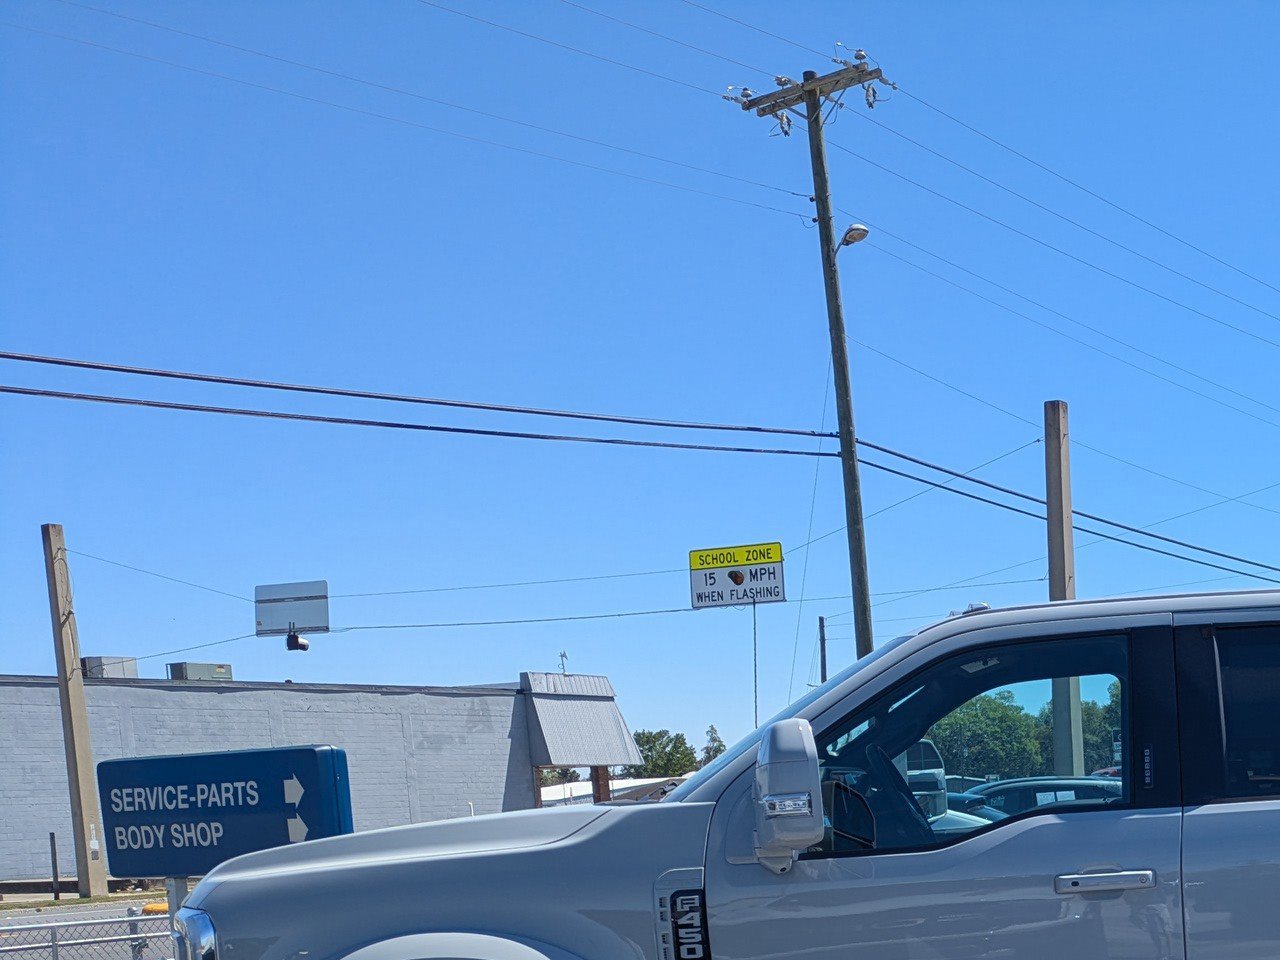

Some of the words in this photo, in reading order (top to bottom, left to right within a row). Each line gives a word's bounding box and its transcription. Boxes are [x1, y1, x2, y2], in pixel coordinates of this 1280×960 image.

[699, 552, 738, 565] SCHOOL
[745, 548, 772, 561] ZONE
[704, 572, 716, 586] 15
[749, 567, 776, 582] MPH
[696, 590, 724, 603] WHEN
[729, 585, 780, 600] FLASHING
[110, 780, 260, 813] SERVICE-PARTS
[114, 824, 165, 850] BODY
[170, 822, 224, 849] SHOP
